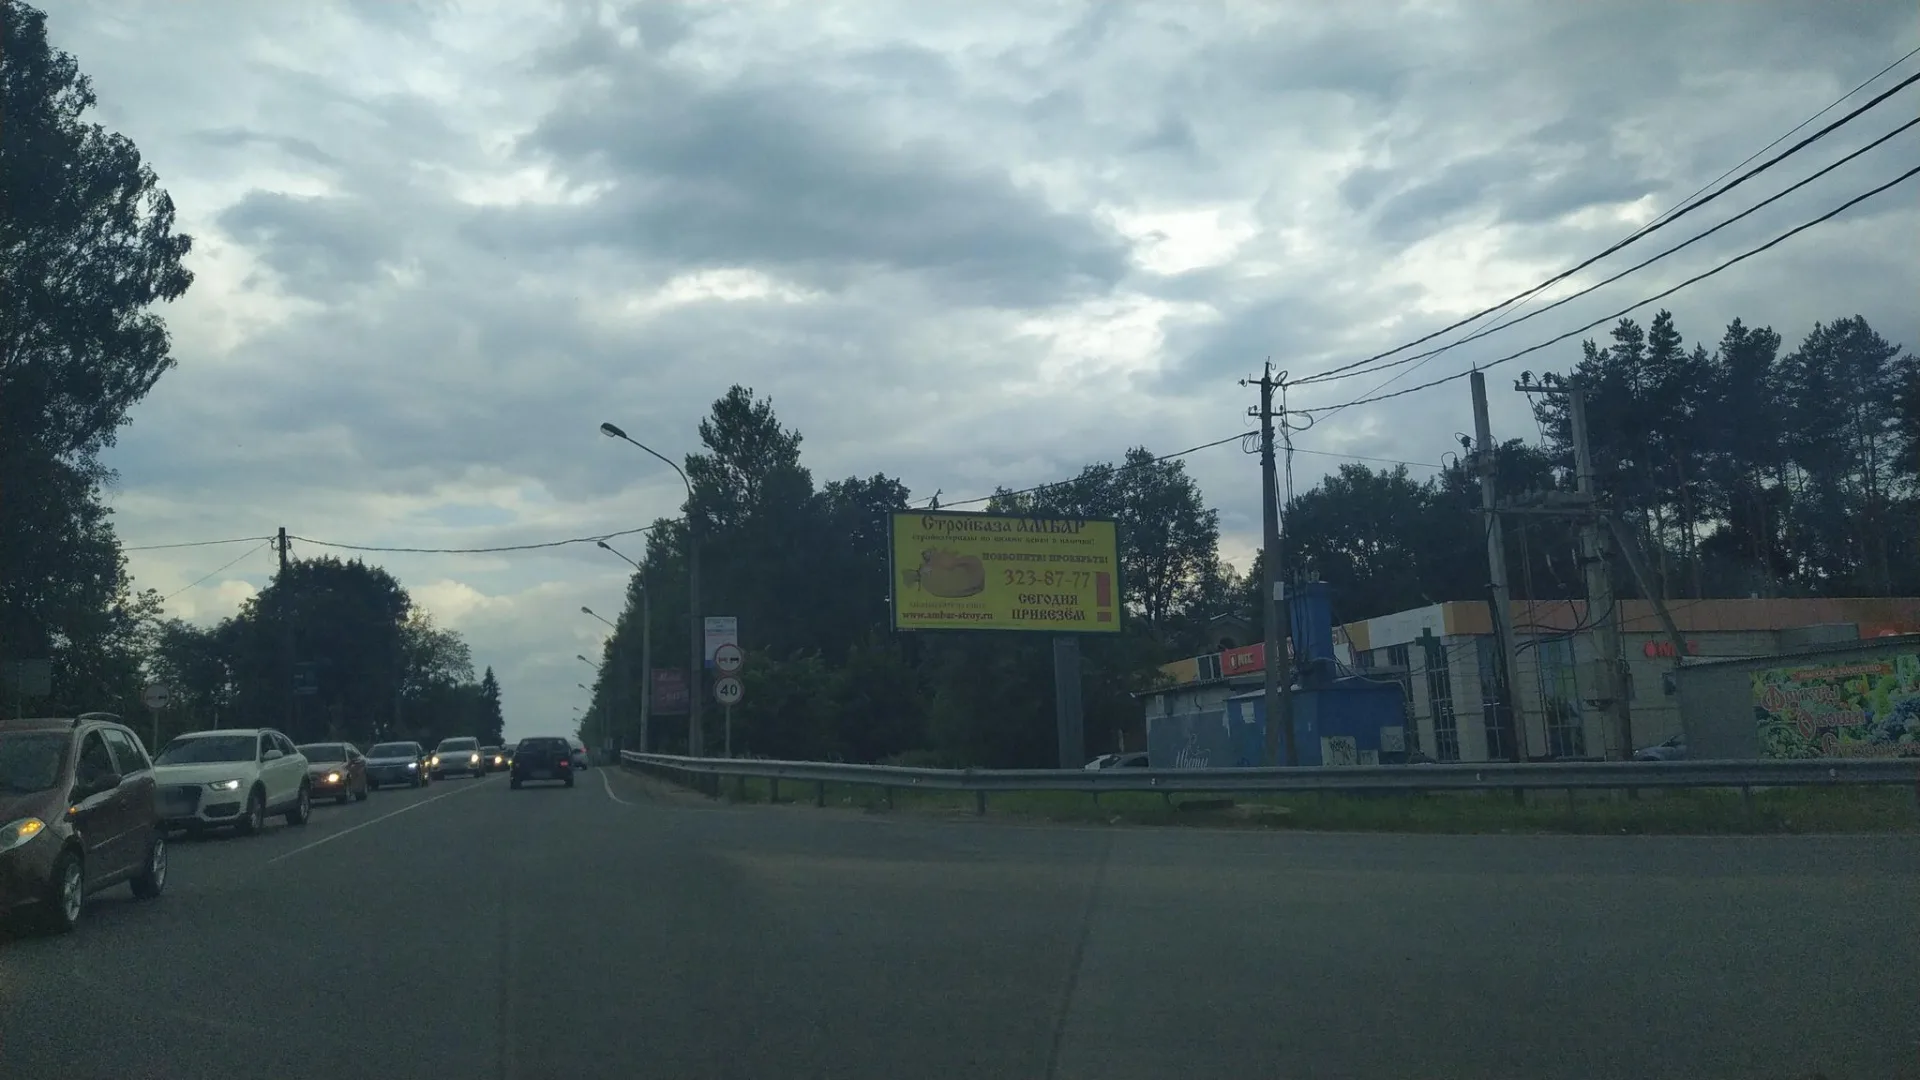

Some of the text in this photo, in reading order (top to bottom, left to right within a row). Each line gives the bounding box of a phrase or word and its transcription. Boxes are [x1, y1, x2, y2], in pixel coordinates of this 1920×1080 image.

[1004, 569, 1091, 589] 323-87-77
[1018, 593, 1079, 606] СЕГОДНЯ
[720, 684, 738, 697] 40
